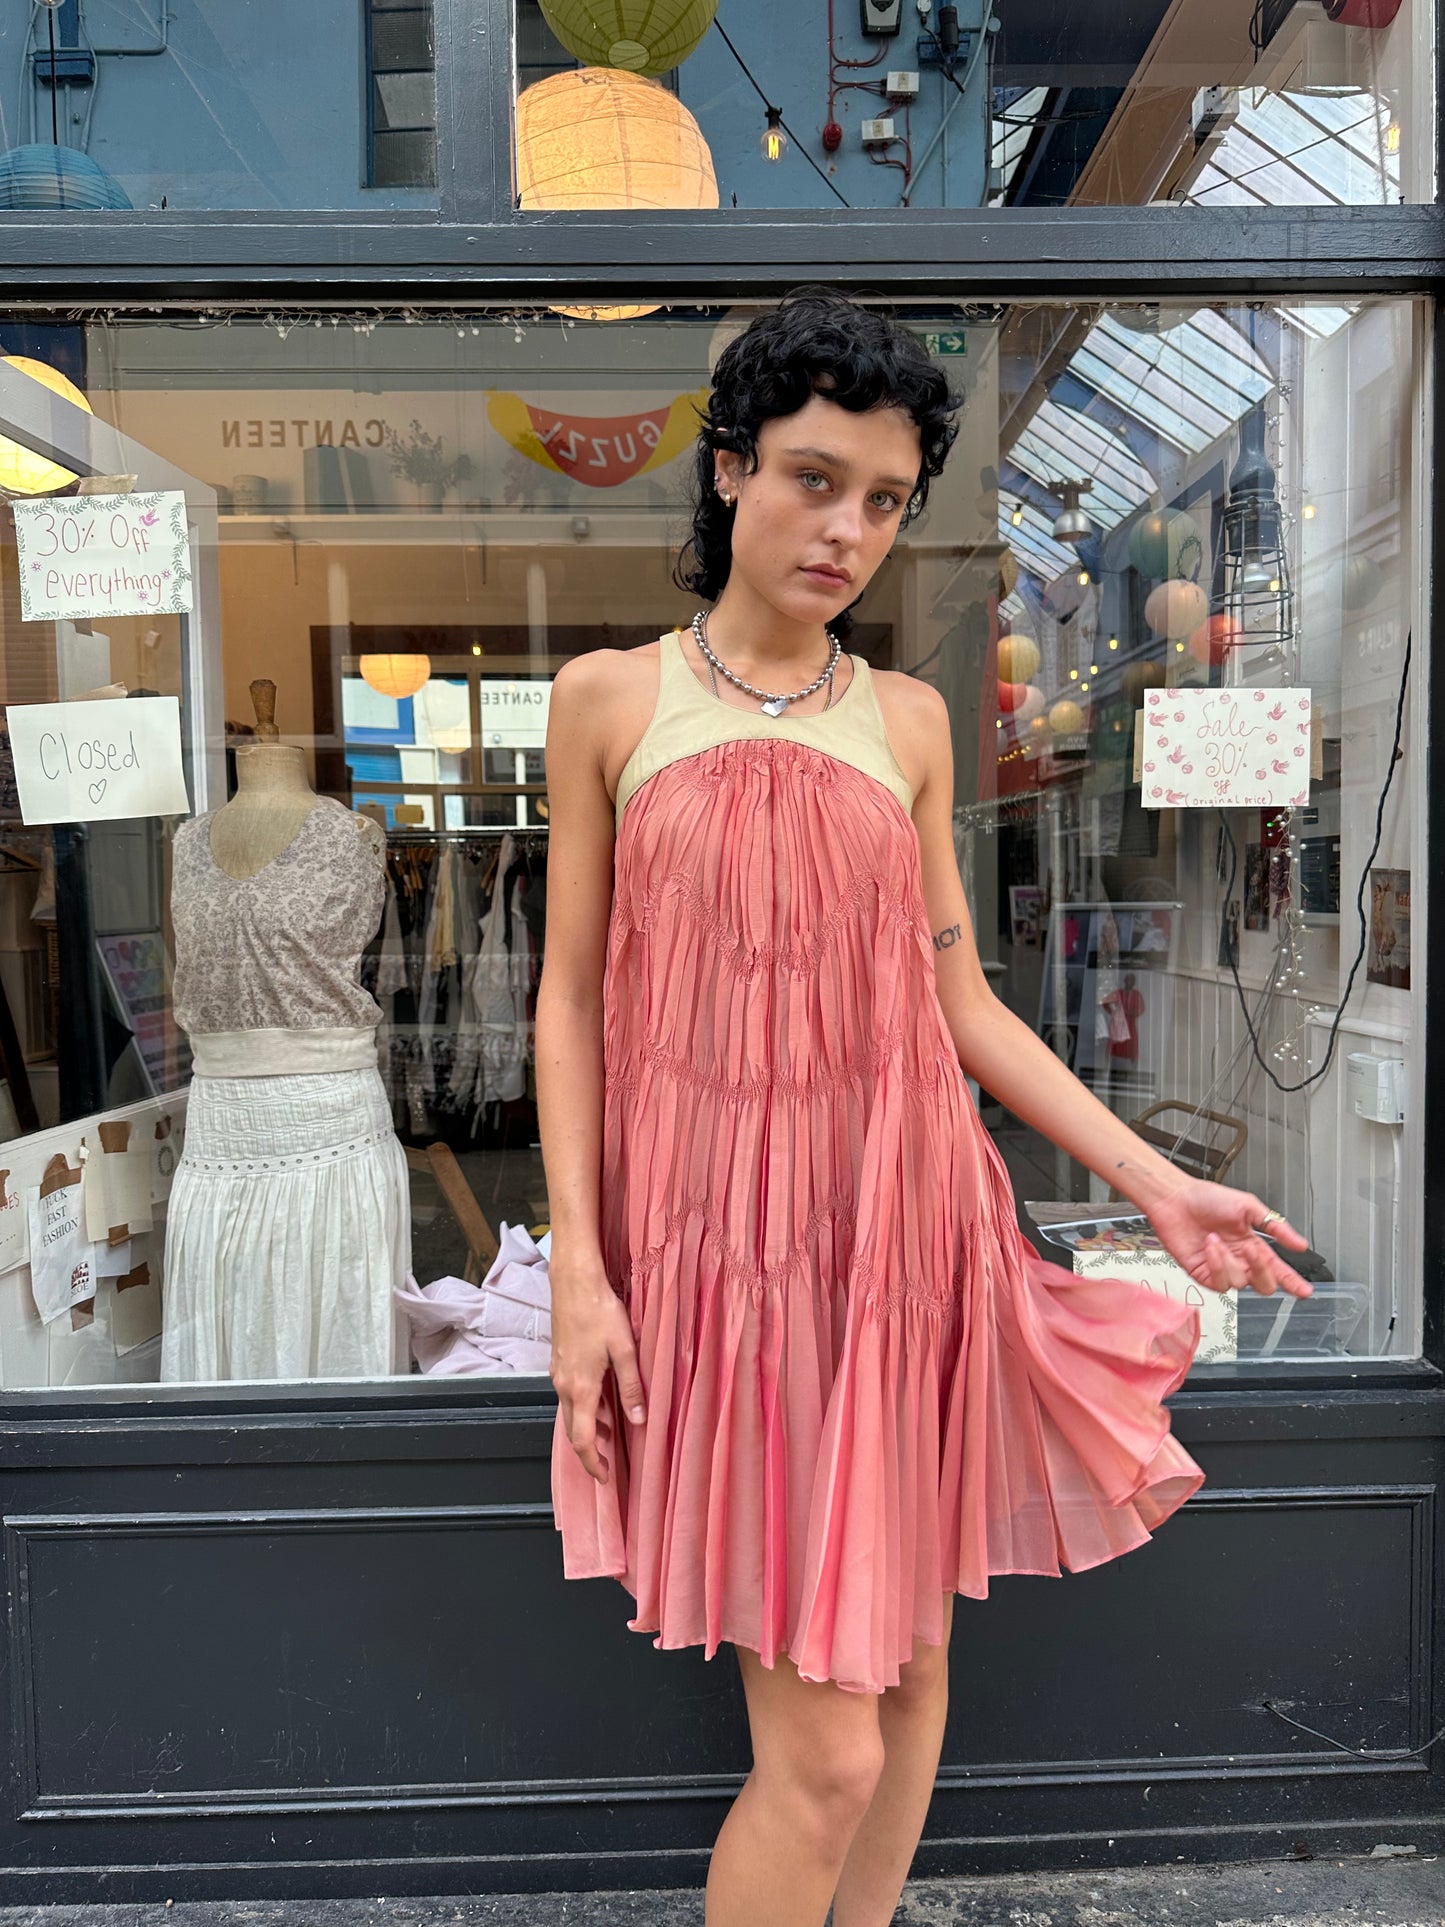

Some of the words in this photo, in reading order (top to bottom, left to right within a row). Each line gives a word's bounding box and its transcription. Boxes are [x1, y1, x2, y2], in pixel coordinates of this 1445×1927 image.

[34, 513, 96, 557] 30%
[45, 566, 163, 607] everything
[1196, 701, 1264, 739] Sale
[39, 730, 141, 780] Closed
[1204, 741, 1248, 778] 30%
[1213, 778, 1231, 796] off
[42, 1216, 79, 1248] FASHION
[47, 1204, 68, 1226] FAST
